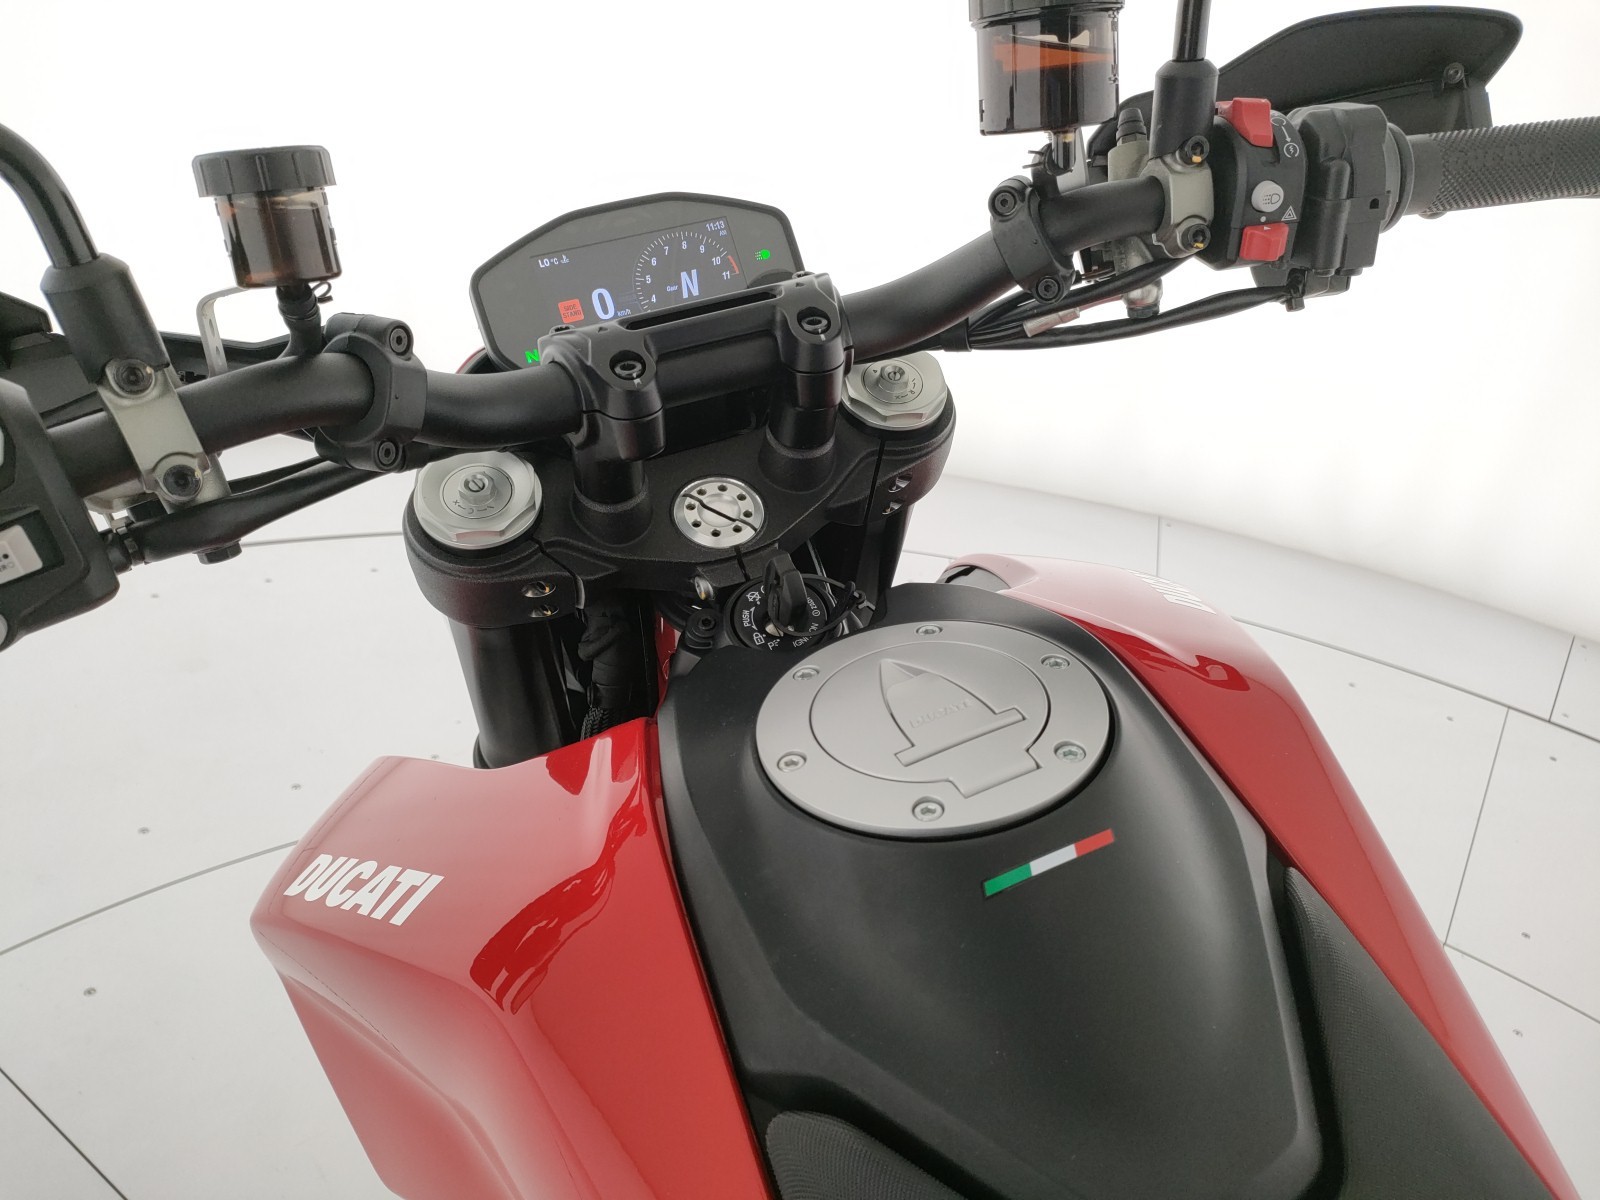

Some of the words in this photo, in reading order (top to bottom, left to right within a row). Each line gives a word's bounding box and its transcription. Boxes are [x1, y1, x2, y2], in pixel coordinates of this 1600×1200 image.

[706, 221, 725, 232] 11:13
[681, 241, 687, 249] 8
[699, 245, 705, 253] 9
[663, 246, 669, 255] 7
[651, 257, 657, 266] 6
[711, 257, 721, 266] 10
[645, 275, 651, 284] 5
[722, 271, 731, 280] 11
[680, 269, 699, 299] N
[651, 294, 657, 303] 4
[563, 304, 577, 312] SIDE
[591, 288, 615, 320] 0
[562, 310, 581, 319] STAND
[525, 349, 540, 364] N
[742, 609, 751, 627] PUSH
[283, 853, 445, 927] DUCATI
